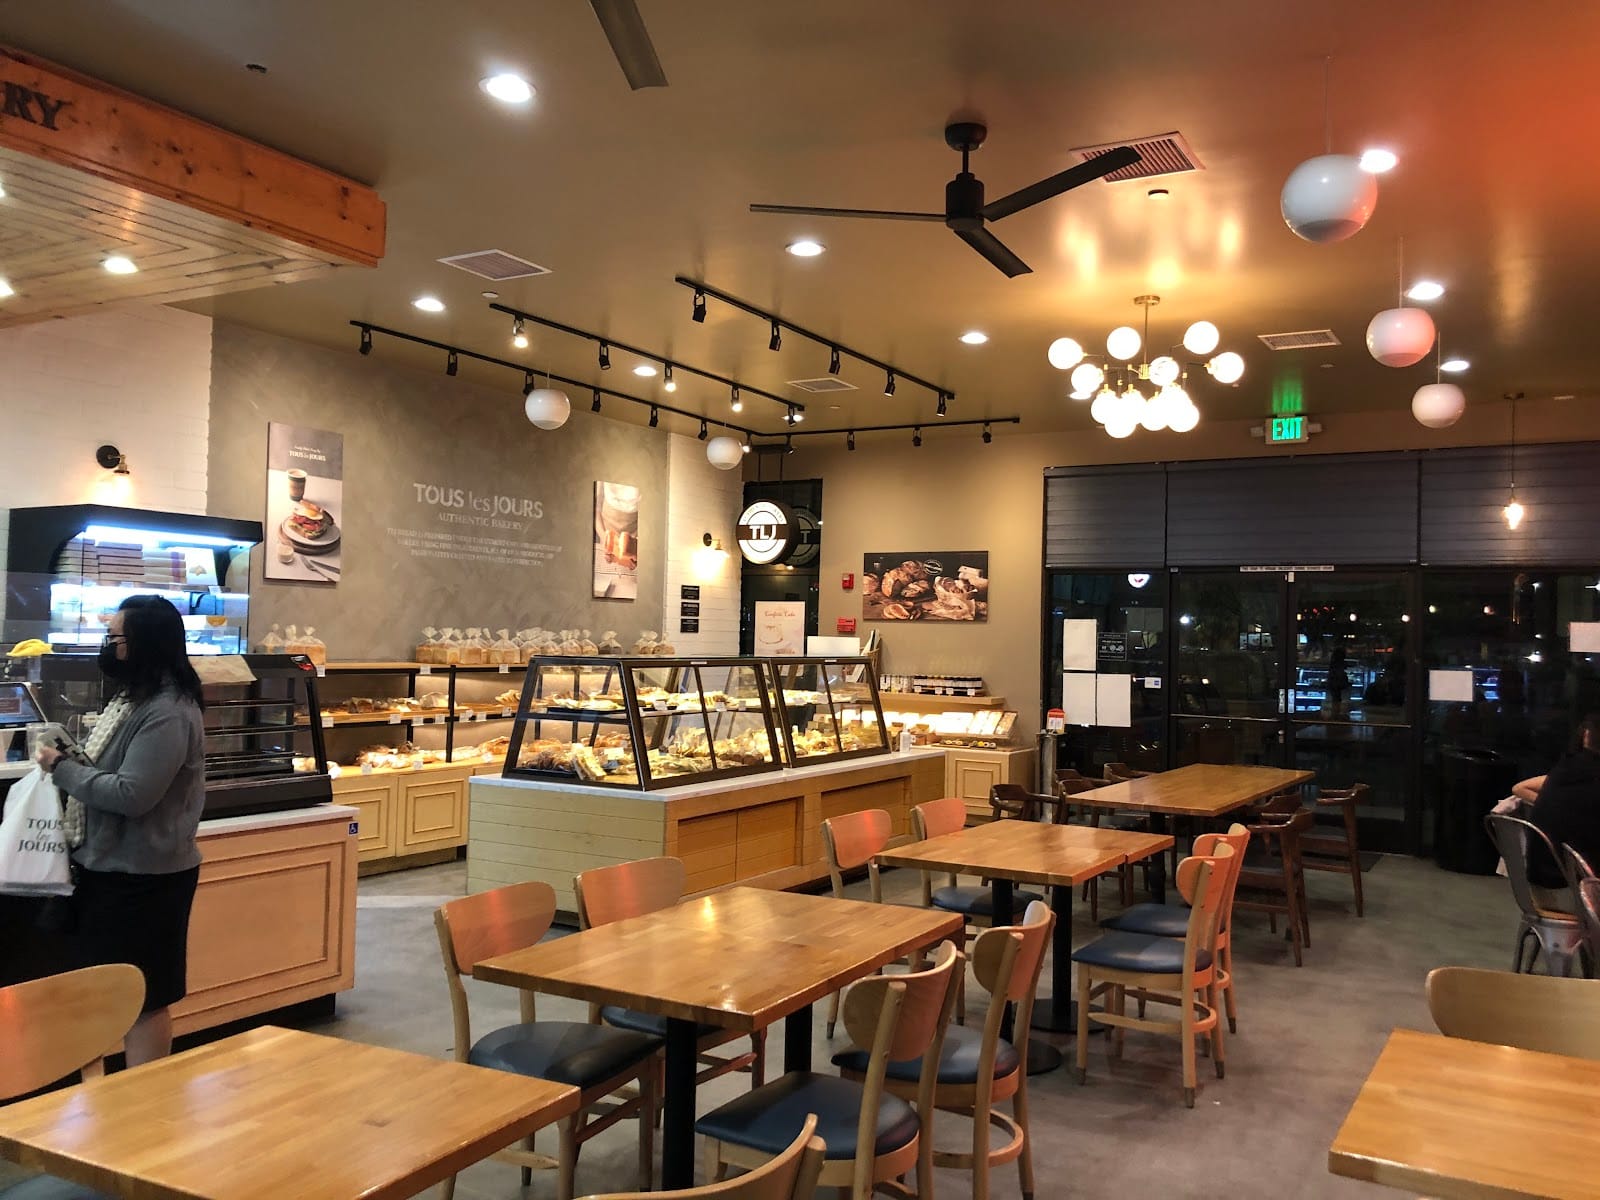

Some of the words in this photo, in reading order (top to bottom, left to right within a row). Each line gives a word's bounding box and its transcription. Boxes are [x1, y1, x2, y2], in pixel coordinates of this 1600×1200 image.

[0, 80, 73, 131] RY
[1272, 417, 1303, 441] EXIT
[413, 482, 465, 508] TOUS
[468, 490, 491, 512] les
[490, 495, 544, 519] JOURS
[438, 513, 489, 527] AUTHENTIC
[749, 525, 777, 540] TLJ
[28, 818, 65, 831] TOUS
[17, 839, 66, 854] JOURS
